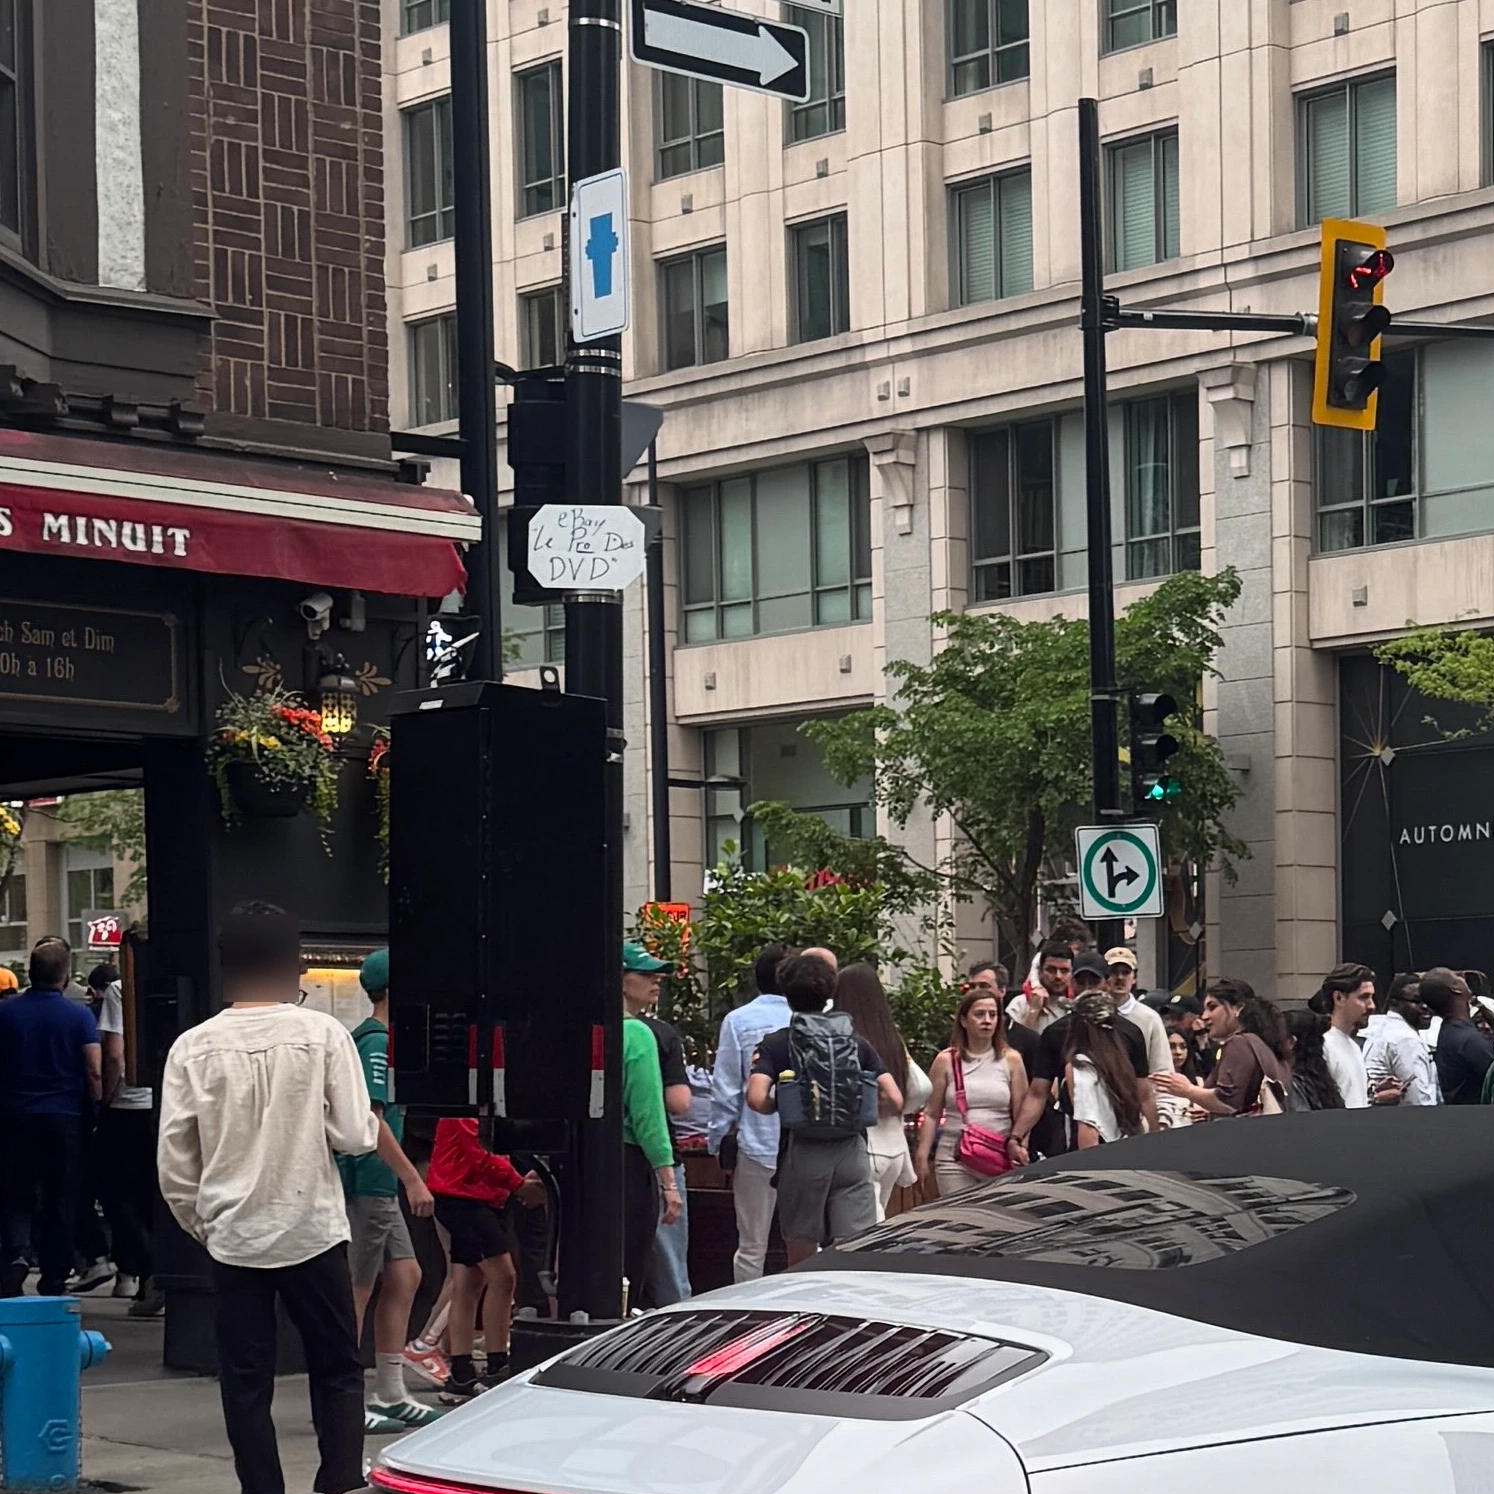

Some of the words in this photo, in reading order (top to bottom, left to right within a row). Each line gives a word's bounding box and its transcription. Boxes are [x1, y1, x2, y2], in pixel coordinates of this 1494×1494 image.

[43, 512, 191, 557] MINUIT
[21, 621, 55, 649] Sam
[61, 628, 77, 648] et
[84, 626, 115, 655] Dim
[46, 656, 75, 683] 16h
